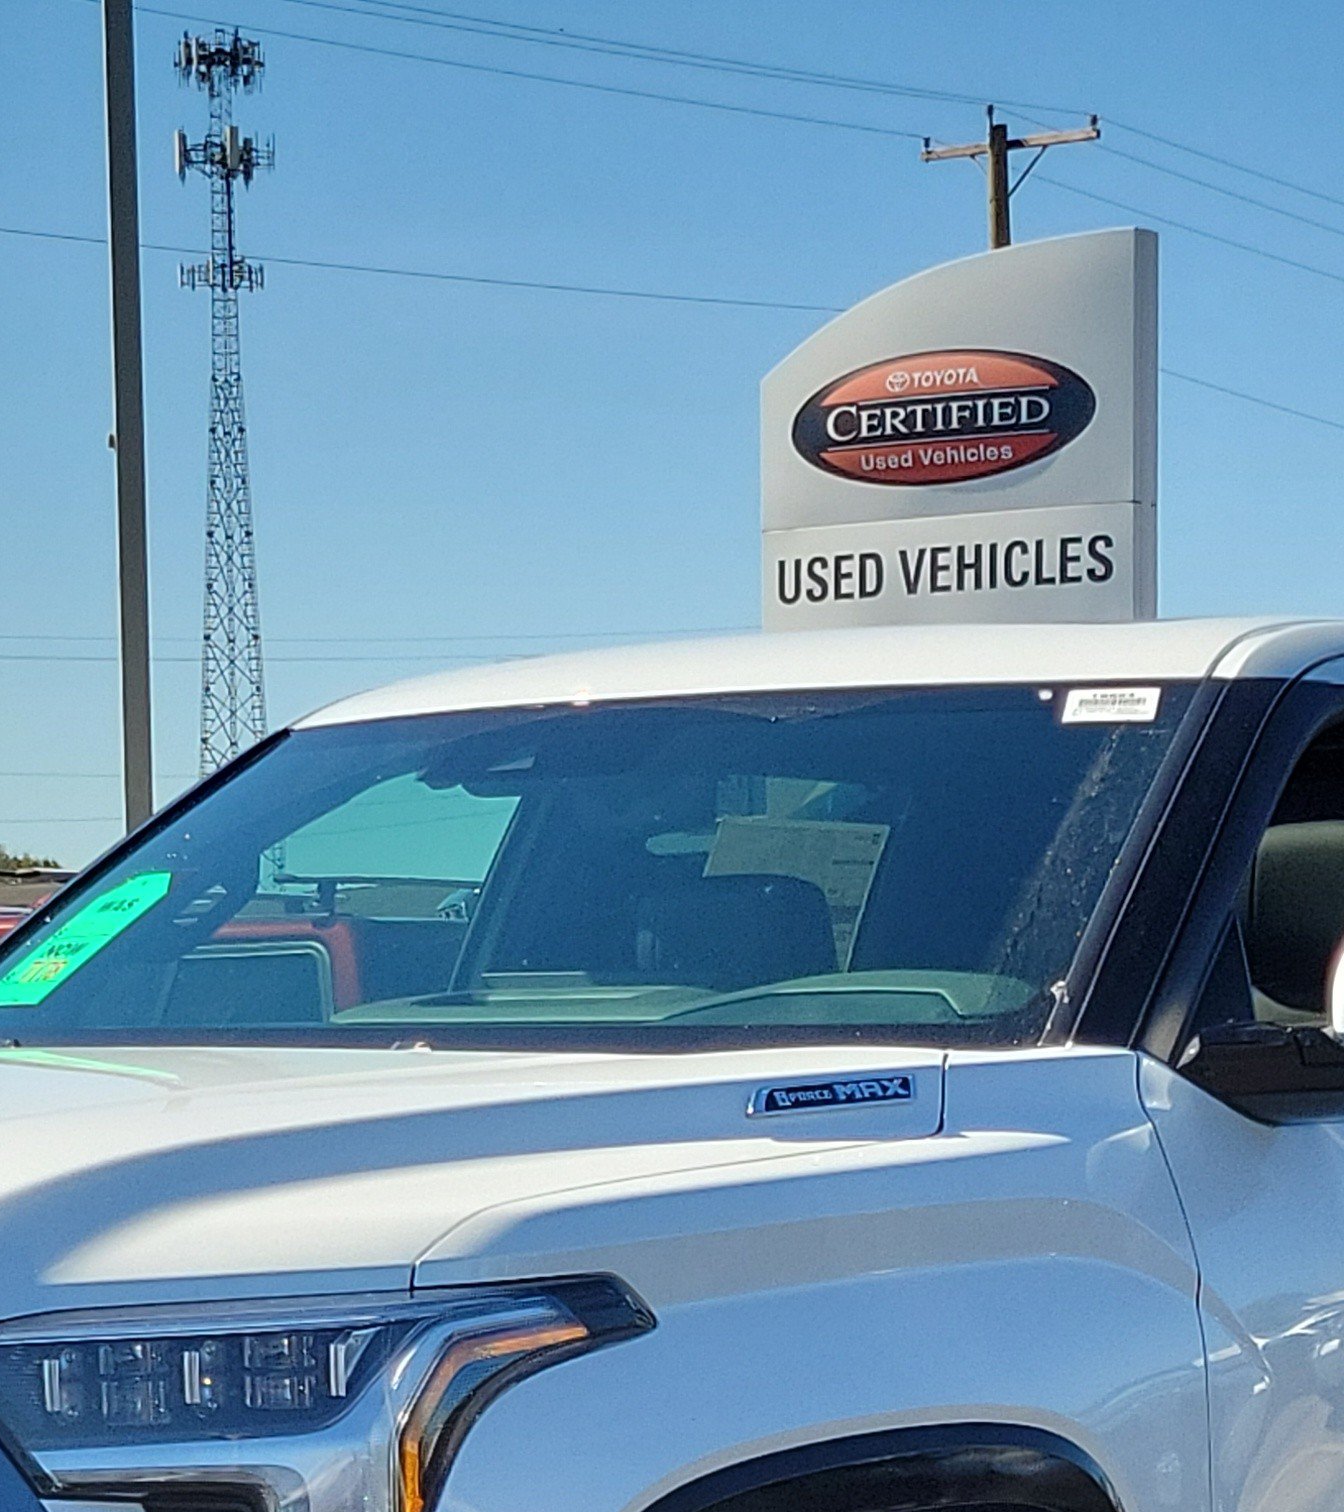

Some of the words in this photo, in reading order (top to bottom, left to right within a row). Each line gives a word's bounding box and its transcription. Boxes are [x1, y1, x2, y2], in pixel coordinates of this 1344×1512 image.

[911, 367, 979, 389] TOYOTA
[825, 395, 1052, 443] CERTIFIED
[860, 450, 913, 472] Used
[919, 442, 1014, 467] Vehicles
[777, 551, 884, 605] USED
[899, 534, 1115, 596] VEHICLES
[832, 1077, 909, 1101] MAX
